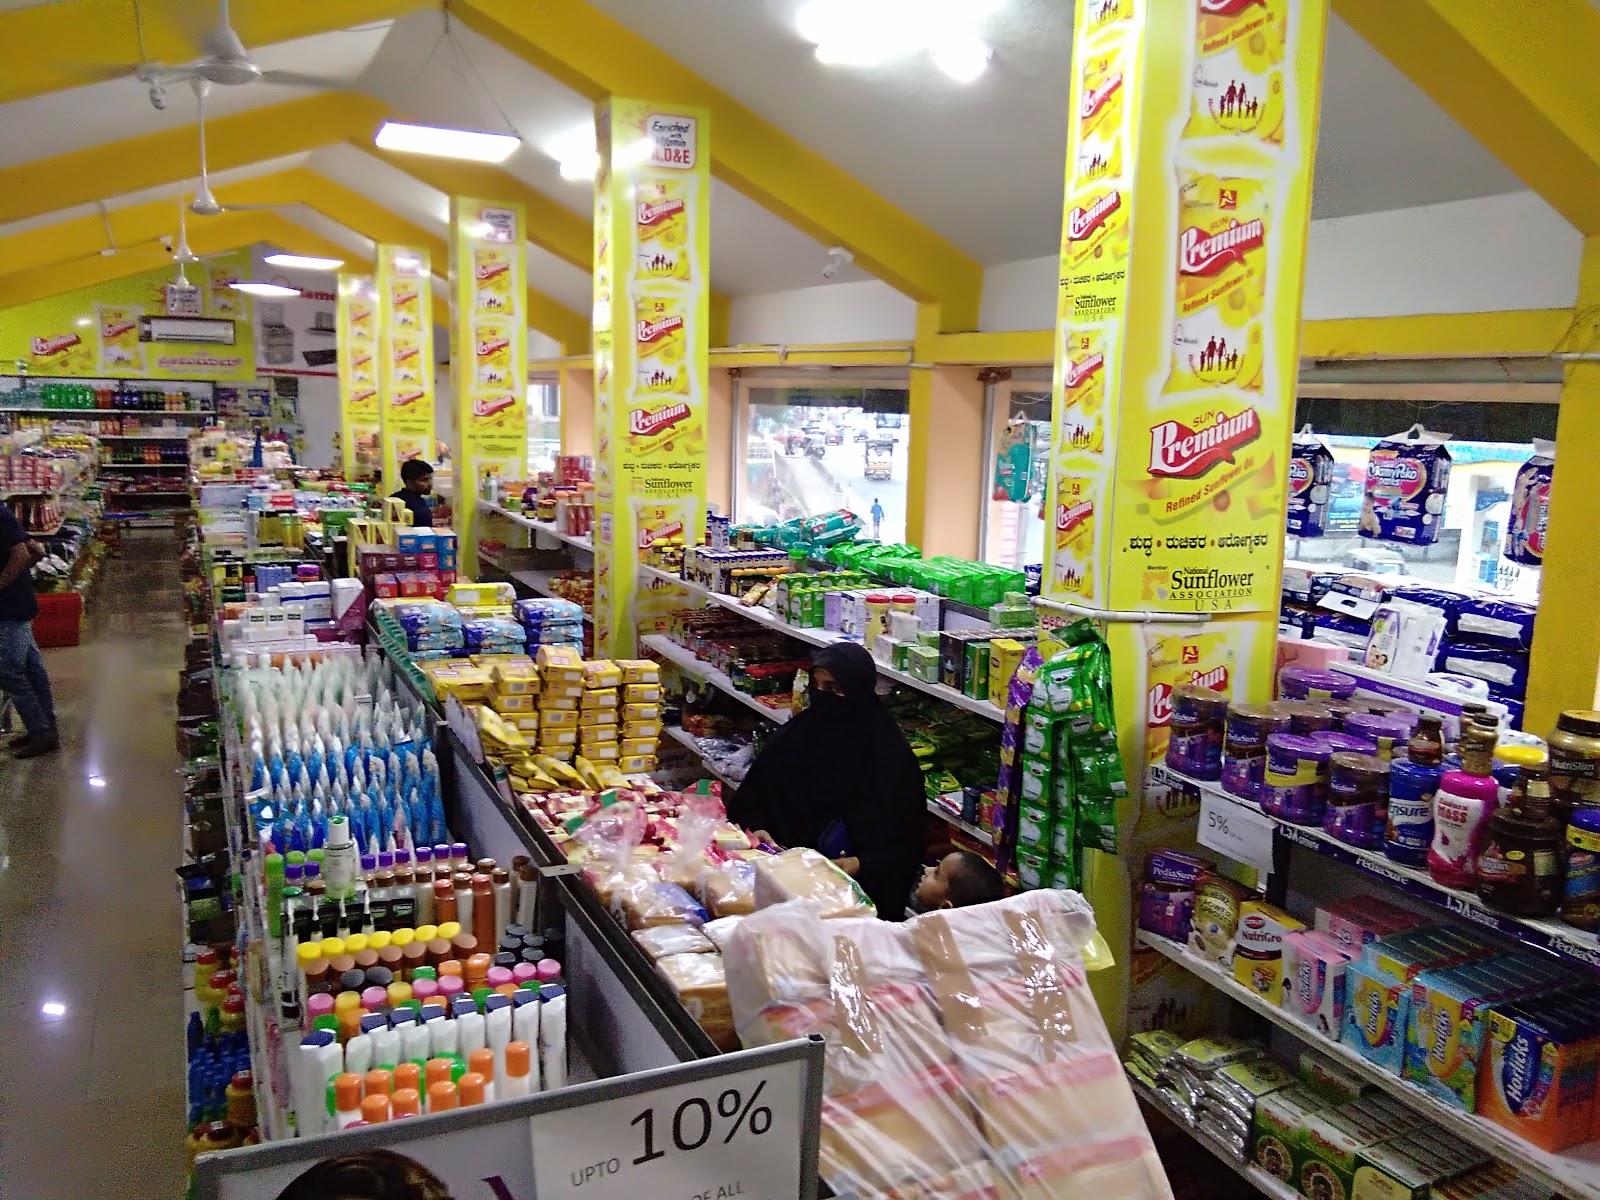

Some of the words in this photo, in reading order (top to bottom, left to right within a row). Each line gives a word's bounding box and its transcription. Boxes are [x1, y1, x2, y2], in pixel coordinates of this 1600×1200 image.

[652, 121, 690, 133] Enriched
[1180, 218, 1263, 276] Premium
[1074, 296, 1117, 309] Sunflower
[630, 403, 690, 435] Premium
[1193, 410, 1215, 427] SUN
[1148, 408, 1259, 476] Premium
[645, 478, 693, 489] Sunflower
[1166, 493, 1201, 513] Refined
[1202, 467, 1242, 496] Sunflower
[1165, 535, 1207, 550] ರುಚಿಕರ
[1171, 569, 1254, 590] Sunflower
[1183, 566, 1209, 576] National
[1169, 588, 1252, 599] ASSOCIATION
[1208, 811, 1229, 835] 5%
[1437, 804, 1468, 823] MASS
[1153, 866, 1196, 881] PediaSure
[1432, 1008, 1450, 1064] Horlicks
[1505, 1035, 1530, 1103] Horlicks
[571, 1158, 620, 1186] UPTO
[631, 1080, 772, 1165] 10%
[717, 1180, 743, 1200] ALL
